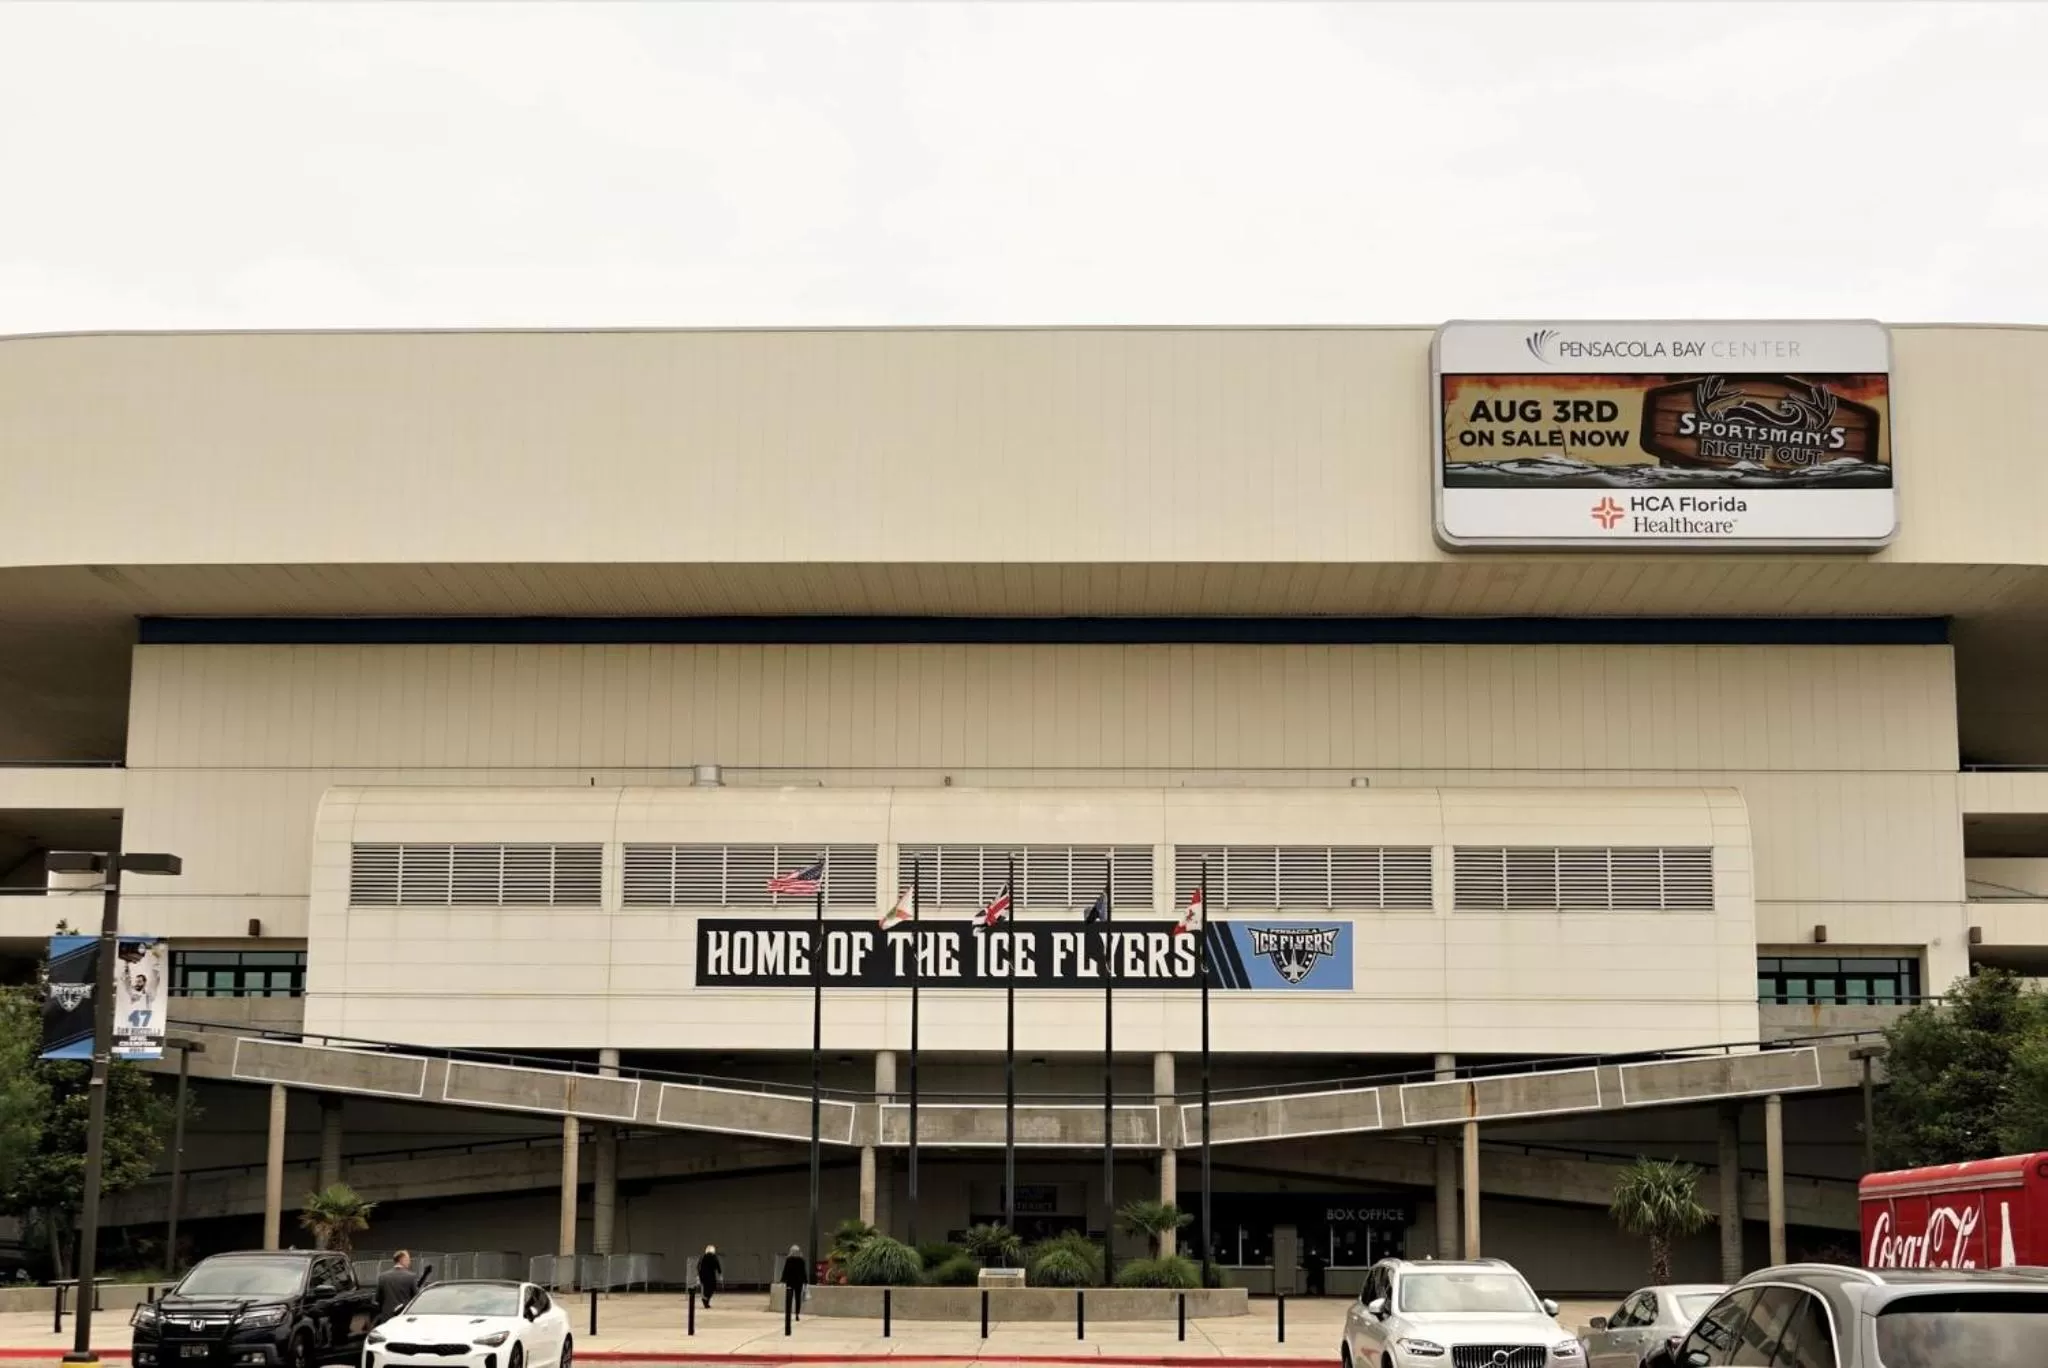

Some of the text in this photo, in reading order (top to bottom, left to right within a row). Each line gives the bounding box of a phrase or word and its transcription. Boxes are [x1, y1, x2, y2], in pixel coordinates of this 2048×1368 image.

[1559, 340, 1801, 358] PENSACOLA BAY CENTER
[1470, 399, 1619, 423] AUG 3RD
[1459, 430, 1630, 446] ON SALE NOW
[1679, 412, 1846, 448] SPORTSMAN'S
[1701, 439, 1824, 466] NIGHT OUT
[1631, 496, 1748, 512] HCA Florida
[1251, 930, 1278, 954] ICE
[707, 930, 1196, 978] HOME OF THE ICE FLYERS
[128, 1010, 153, 1027] 47
[1326, 1207, 1405, 1221] BOX OFFICE
